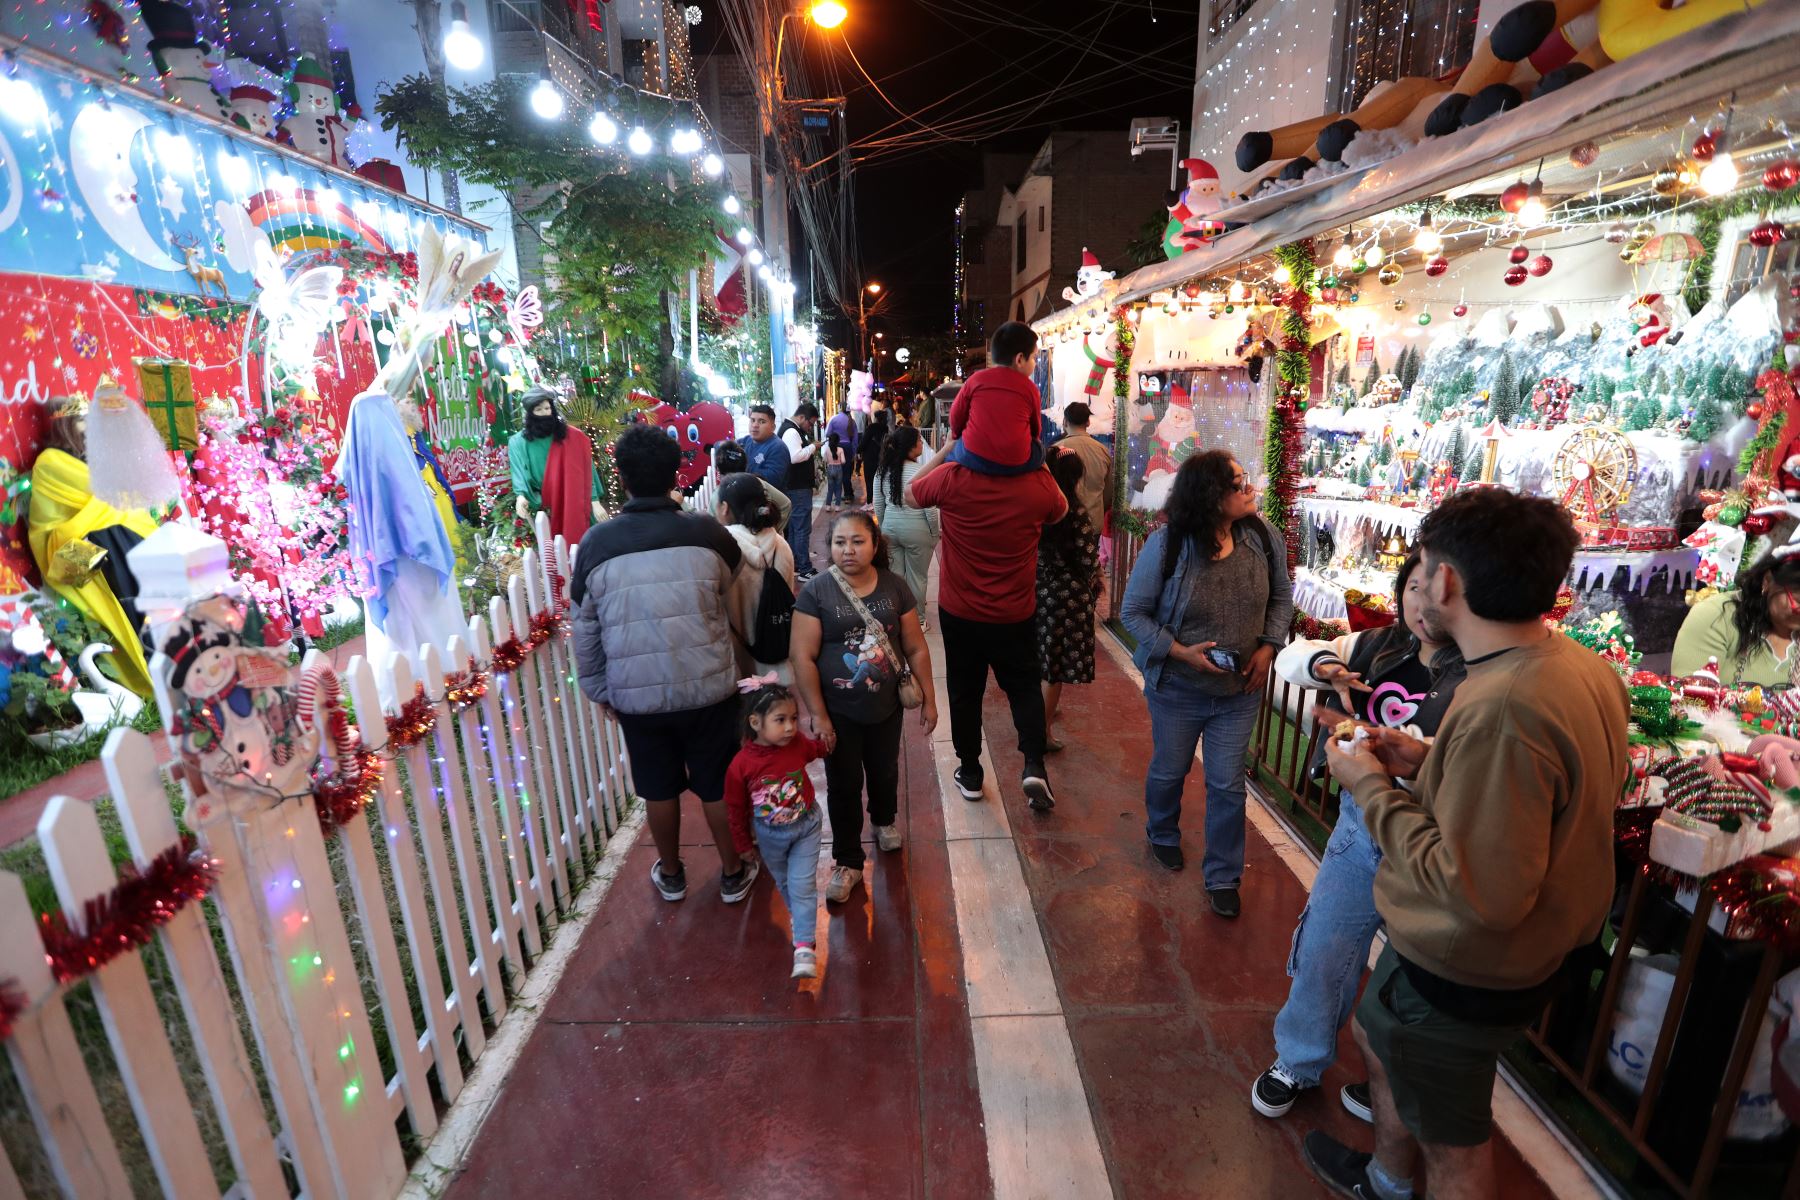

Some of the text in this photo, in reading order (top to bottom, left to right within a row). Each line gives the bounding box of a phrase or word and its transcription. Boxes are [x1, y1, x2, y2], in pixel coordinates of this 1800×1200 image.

[0, 359, 50, 405] ad
[434, 361, 470, 402] Feliz
[427, 400, 490, 451] Navidad
